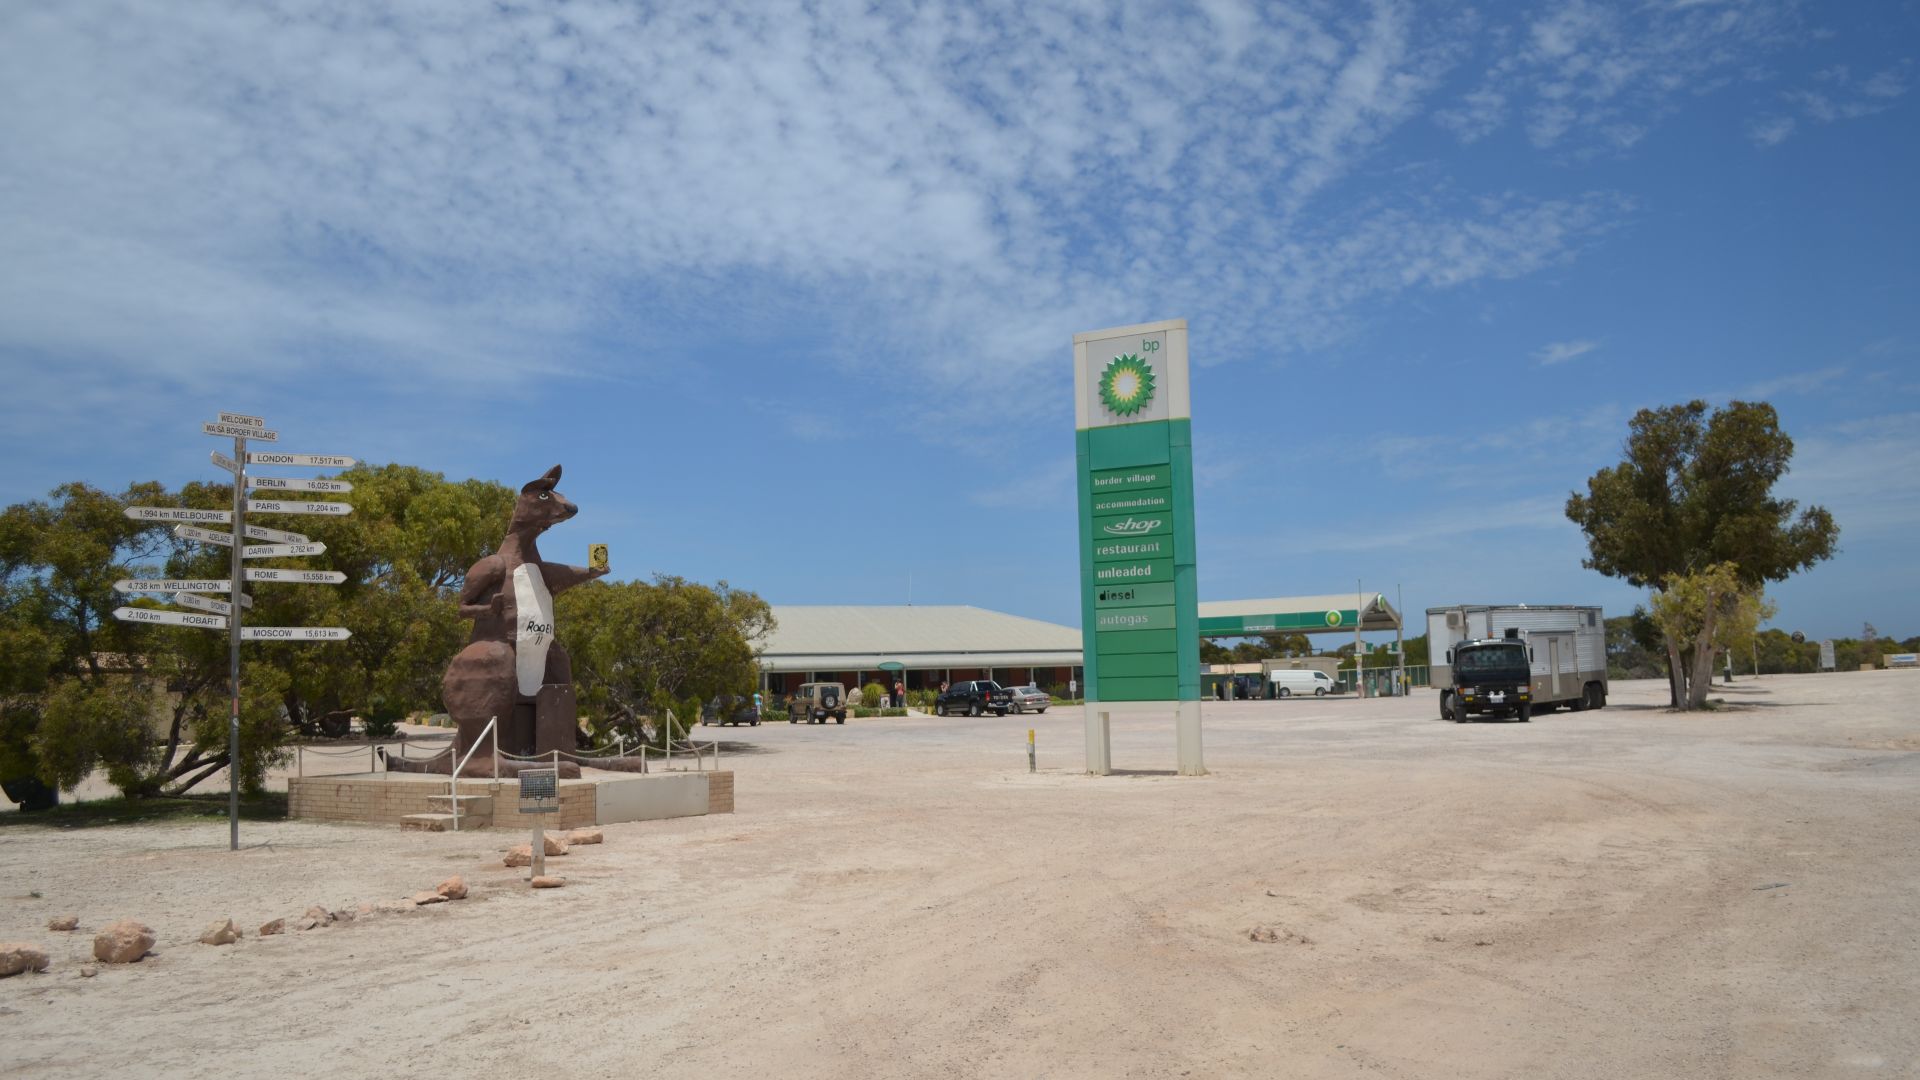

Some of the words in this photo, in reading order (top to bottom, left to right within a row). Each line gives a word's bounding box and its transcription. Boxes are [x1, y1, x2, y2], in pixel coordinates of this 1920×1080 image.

[1142, 339, 1160, 353] bp
[221, 415, 253, 426] WELCOME
[226, 427, 250, 437] BORDER
[252, 430, 276, 440] VILLAGE
[257, 455, 294, 463] LONDON
[334, 457, 344, 465] km
[256, 479, 286, 487] BERLIN
[331, 482, 341, 490] km
[1094, 476, 1123, 486] border
[1127, 473, 1156, 484] village
[256, 502, 280, 510] PARIS
[1096, 497, 1165, 510] accommodation
[160, 510, 170, 518] km
[173, 511, 224, 520] MELBOURNE
[1114, 518, 1162, 532] shop
[208, 532, 231, 544] ADELAIDE
[250, 528, 268, 537] PERTH
[248, 547, 274, 555] DARWIN
[1097, 542, 1160, 555] restaurant
[254, 571, 278, 579] ROME
[324, 573, 334, 581] km
[1098, 565, 1151, 579] unleaded
[149, 582, 161, 590] km
[164, 582, 221, 590] WELLINGTON
[1100, 589, 1135, 601] diesel
[210, 601, 228, 611] SYDNEY
[128, 612, 149, 621] 2,100
[149, 613, 161, 621] km
[182, 616, 219, 626] HOBART
[1100, 613, 1149, 626] autogas
[253, 629, 293, 638] MOSCOW
[328, 630, 338, 638] km
